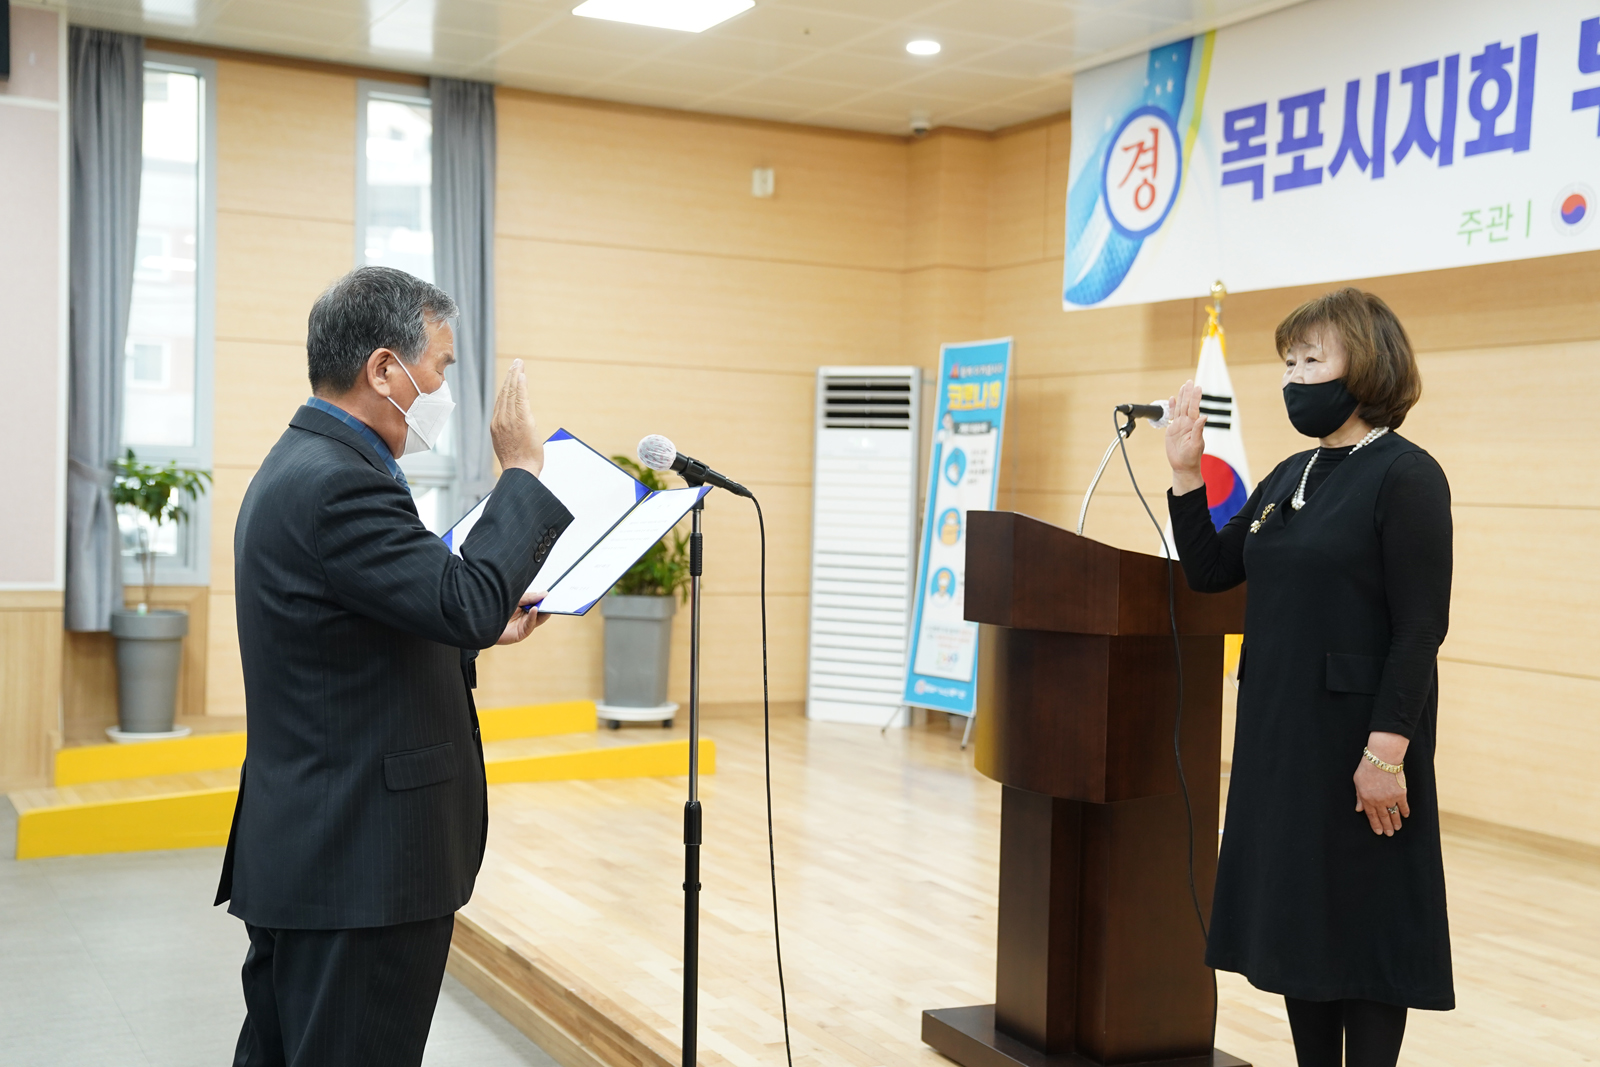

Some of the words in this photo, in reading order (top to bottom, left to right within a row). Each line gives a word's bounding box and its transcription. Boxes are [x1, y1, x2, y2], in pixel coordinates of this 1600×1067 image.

[1221, 33, 1538, 201] 목포시지회
[1119, 127, 1160, 211] 경
[1457, 203, 1513, 246] 주관
